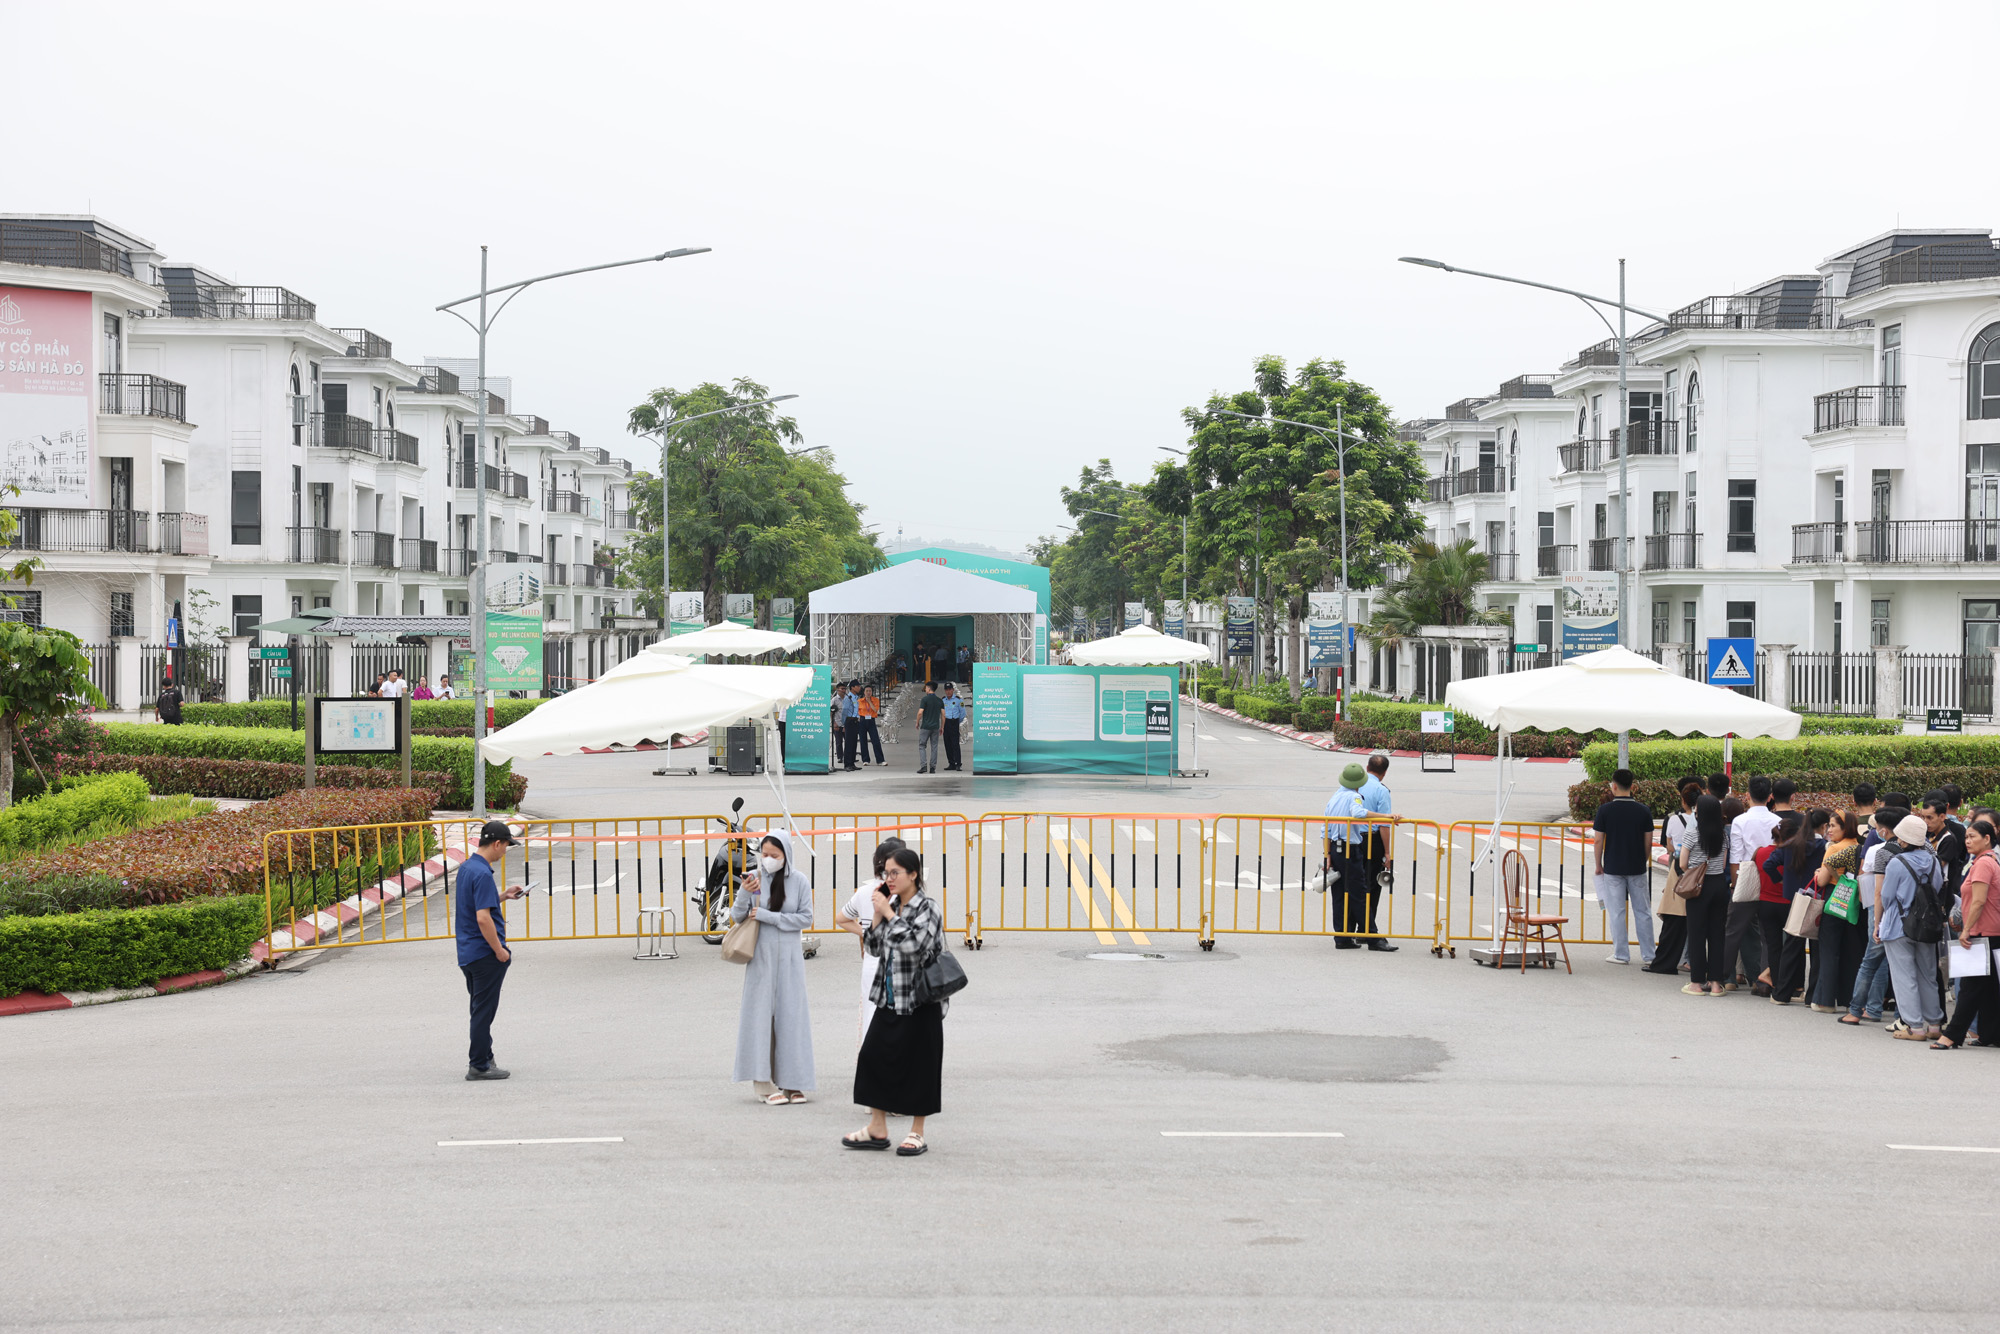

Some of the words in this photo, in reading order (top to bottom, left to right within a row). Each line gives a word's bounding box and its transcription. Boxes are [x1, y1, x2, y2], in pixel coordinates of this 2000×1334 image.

[10, 328, 32, 336] LAND
[10, 337, 31, 354] CỔ
[35, 339, 70, 356] PHẦN
[9, 356, 36, 373] SẢN
[40, 360, 59, 374] HÀ
[64, 360, 84, 375] ĐÔ
[1148, 713, 1157, 725] LỐI
[1158, 715, 1168, 725] VÀO
